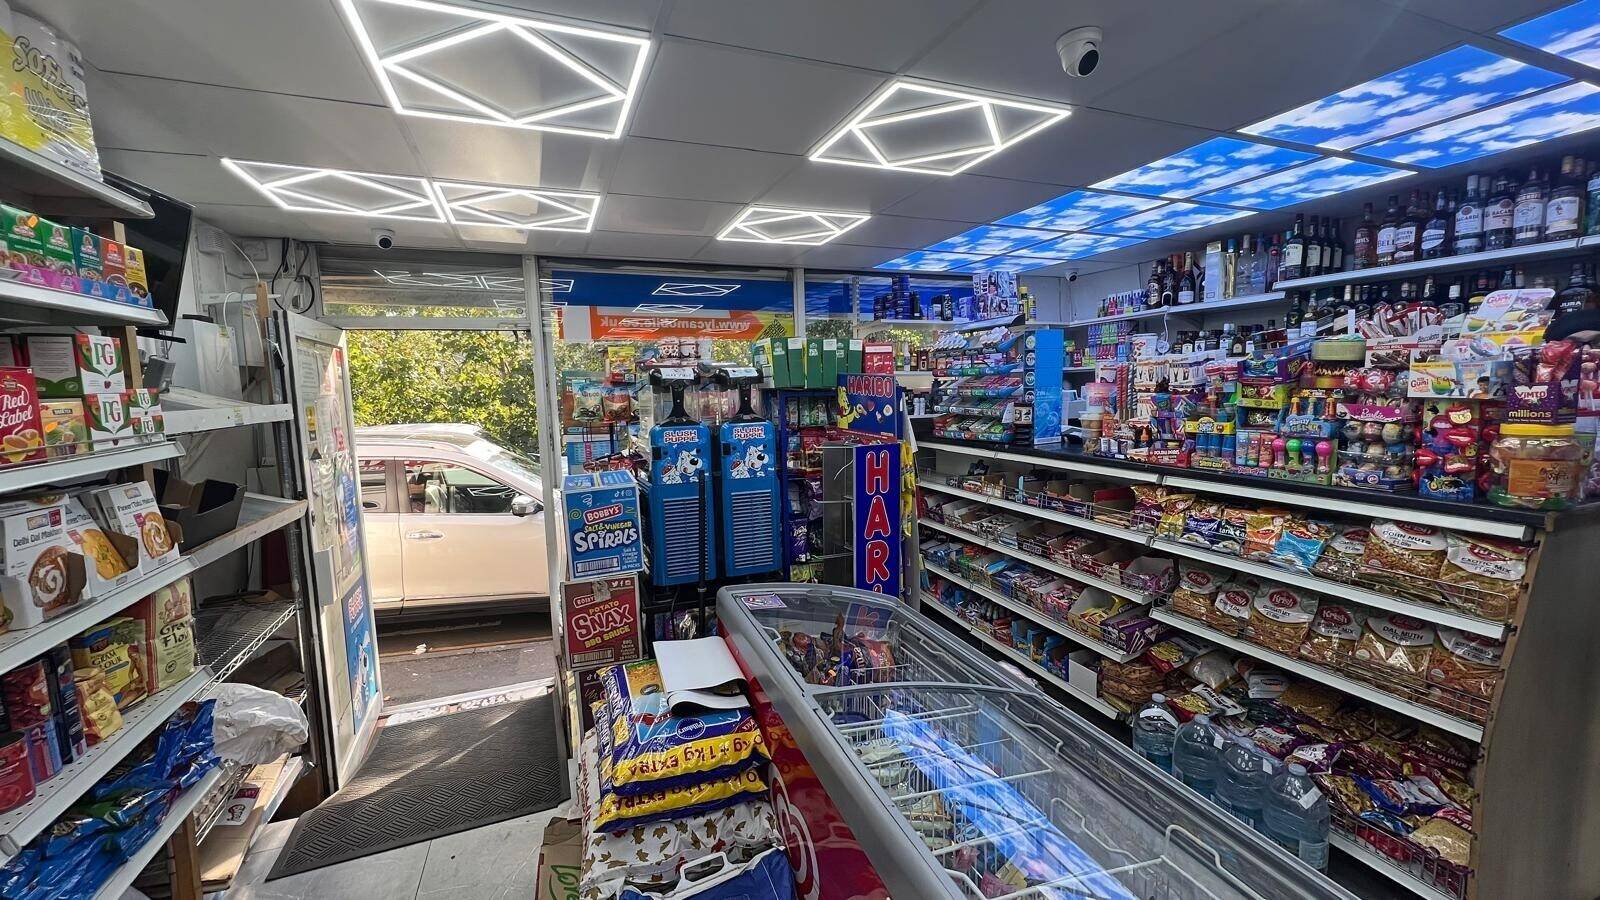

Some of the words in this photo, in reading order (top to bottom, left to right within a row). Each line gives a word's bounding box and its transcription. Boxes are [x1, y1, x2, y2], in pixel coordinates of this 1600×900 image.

[93, 342, 114, 365] PG
[847, 375, 893, 398] HARIBO
[1, 390, 29, 411] Red
[0, 405, 33, 429] Label
[102, 400, 122, 423] PG
[1508, 409, 1552, 418] millions
[587, 506, 619, 521] BOBBY'S
[1407, 535, 1431, 545] NUTS
[1494, 564, 1512, 574] MIX
[589, 600, 620, 615] POTATO
[572, 604, 633, 640] SNAX
[584, 637, 602, 648] BBQ
[602, 625, 631, 640] SAUCE
[1400, 631, 1424, 641] MUTH
[678, 722, 704, 736] Pillsbury
[628, 755, 679, 775] EXTRA
[612, 789, 666, 811] EXTRA
